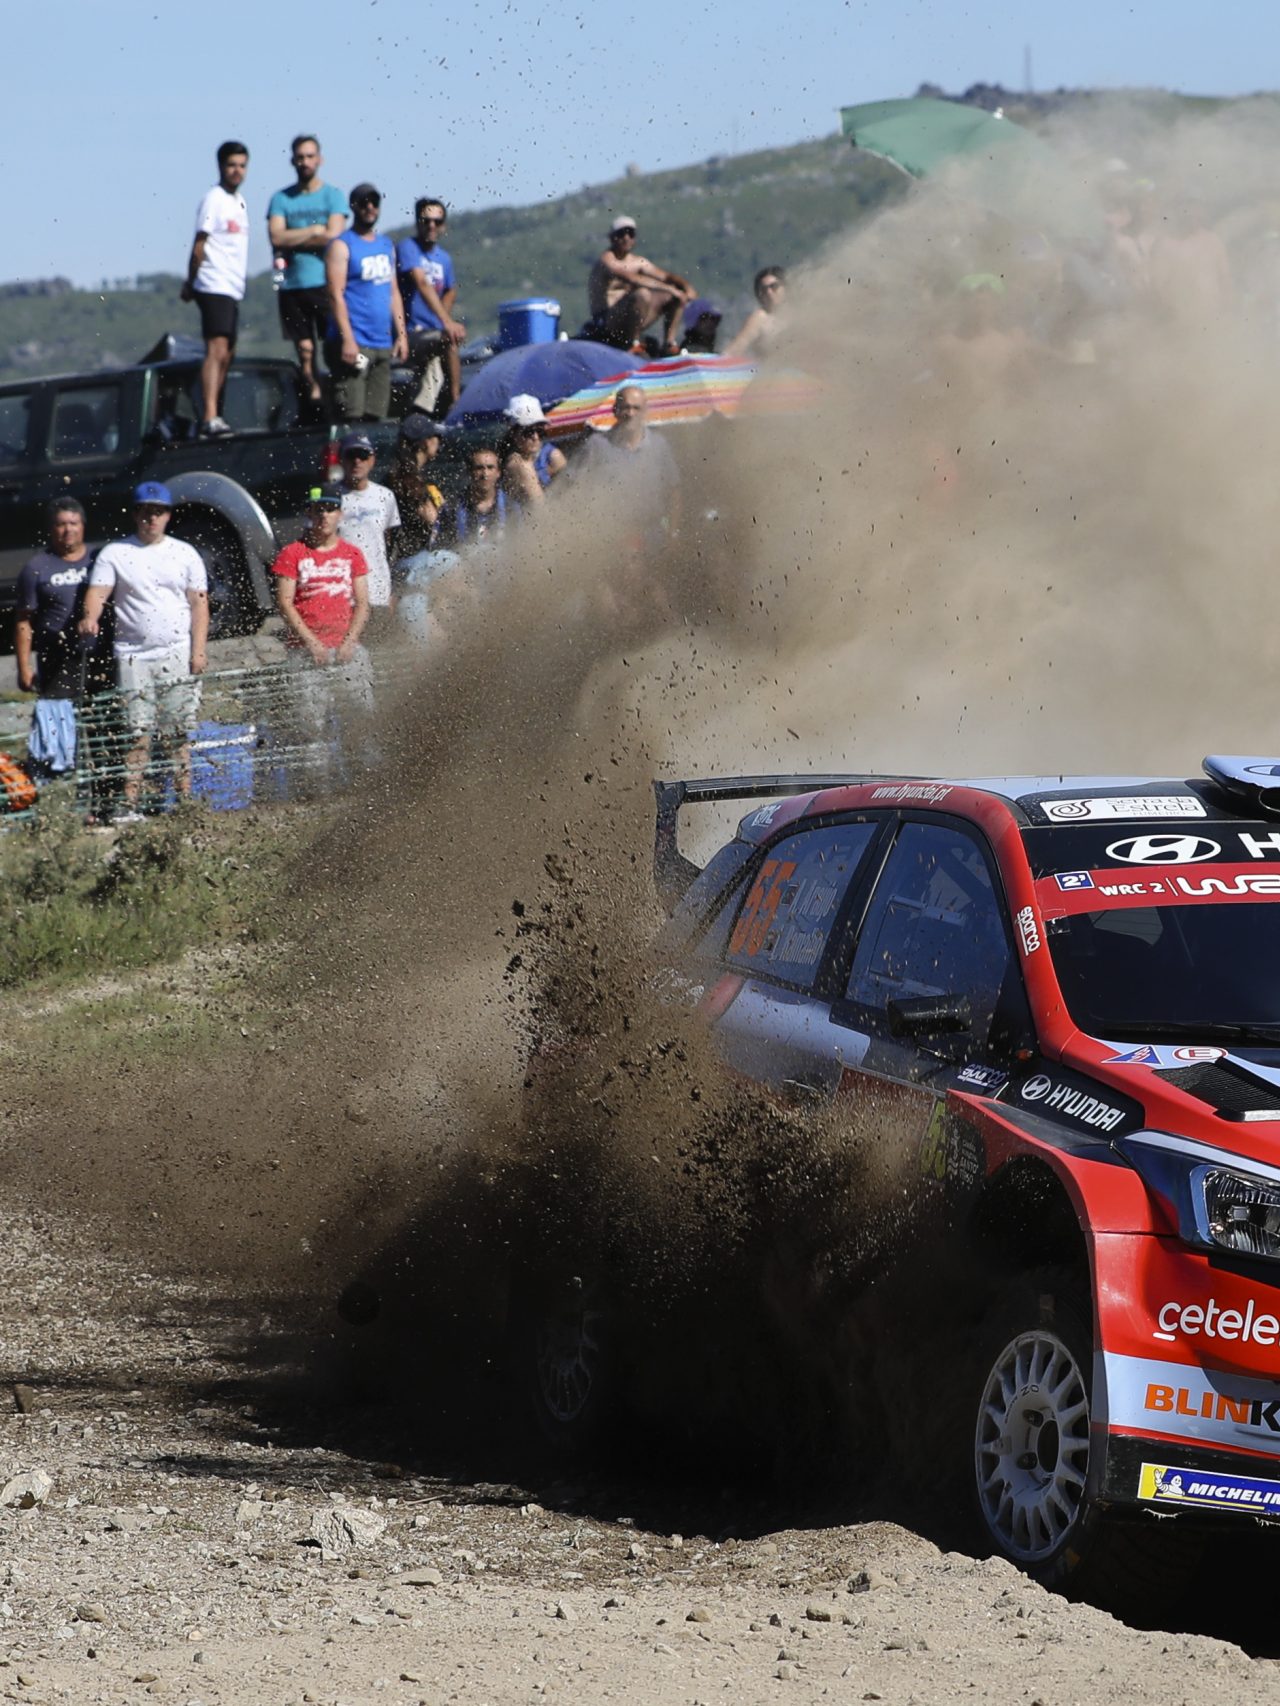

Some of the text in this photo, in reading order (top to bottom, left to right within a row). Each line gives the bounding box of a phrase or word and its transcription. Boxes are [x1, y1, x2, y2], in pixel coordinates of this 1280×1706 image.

[1112, 803, 1199, 812] Estrela
[1098, 883, 1147, 896] WRC
[1149, 882, 1165, 893] 2
[1015, 906, 1041, 956] sparco
[1044, 1083, 1126, 1131] HYUNDAI
